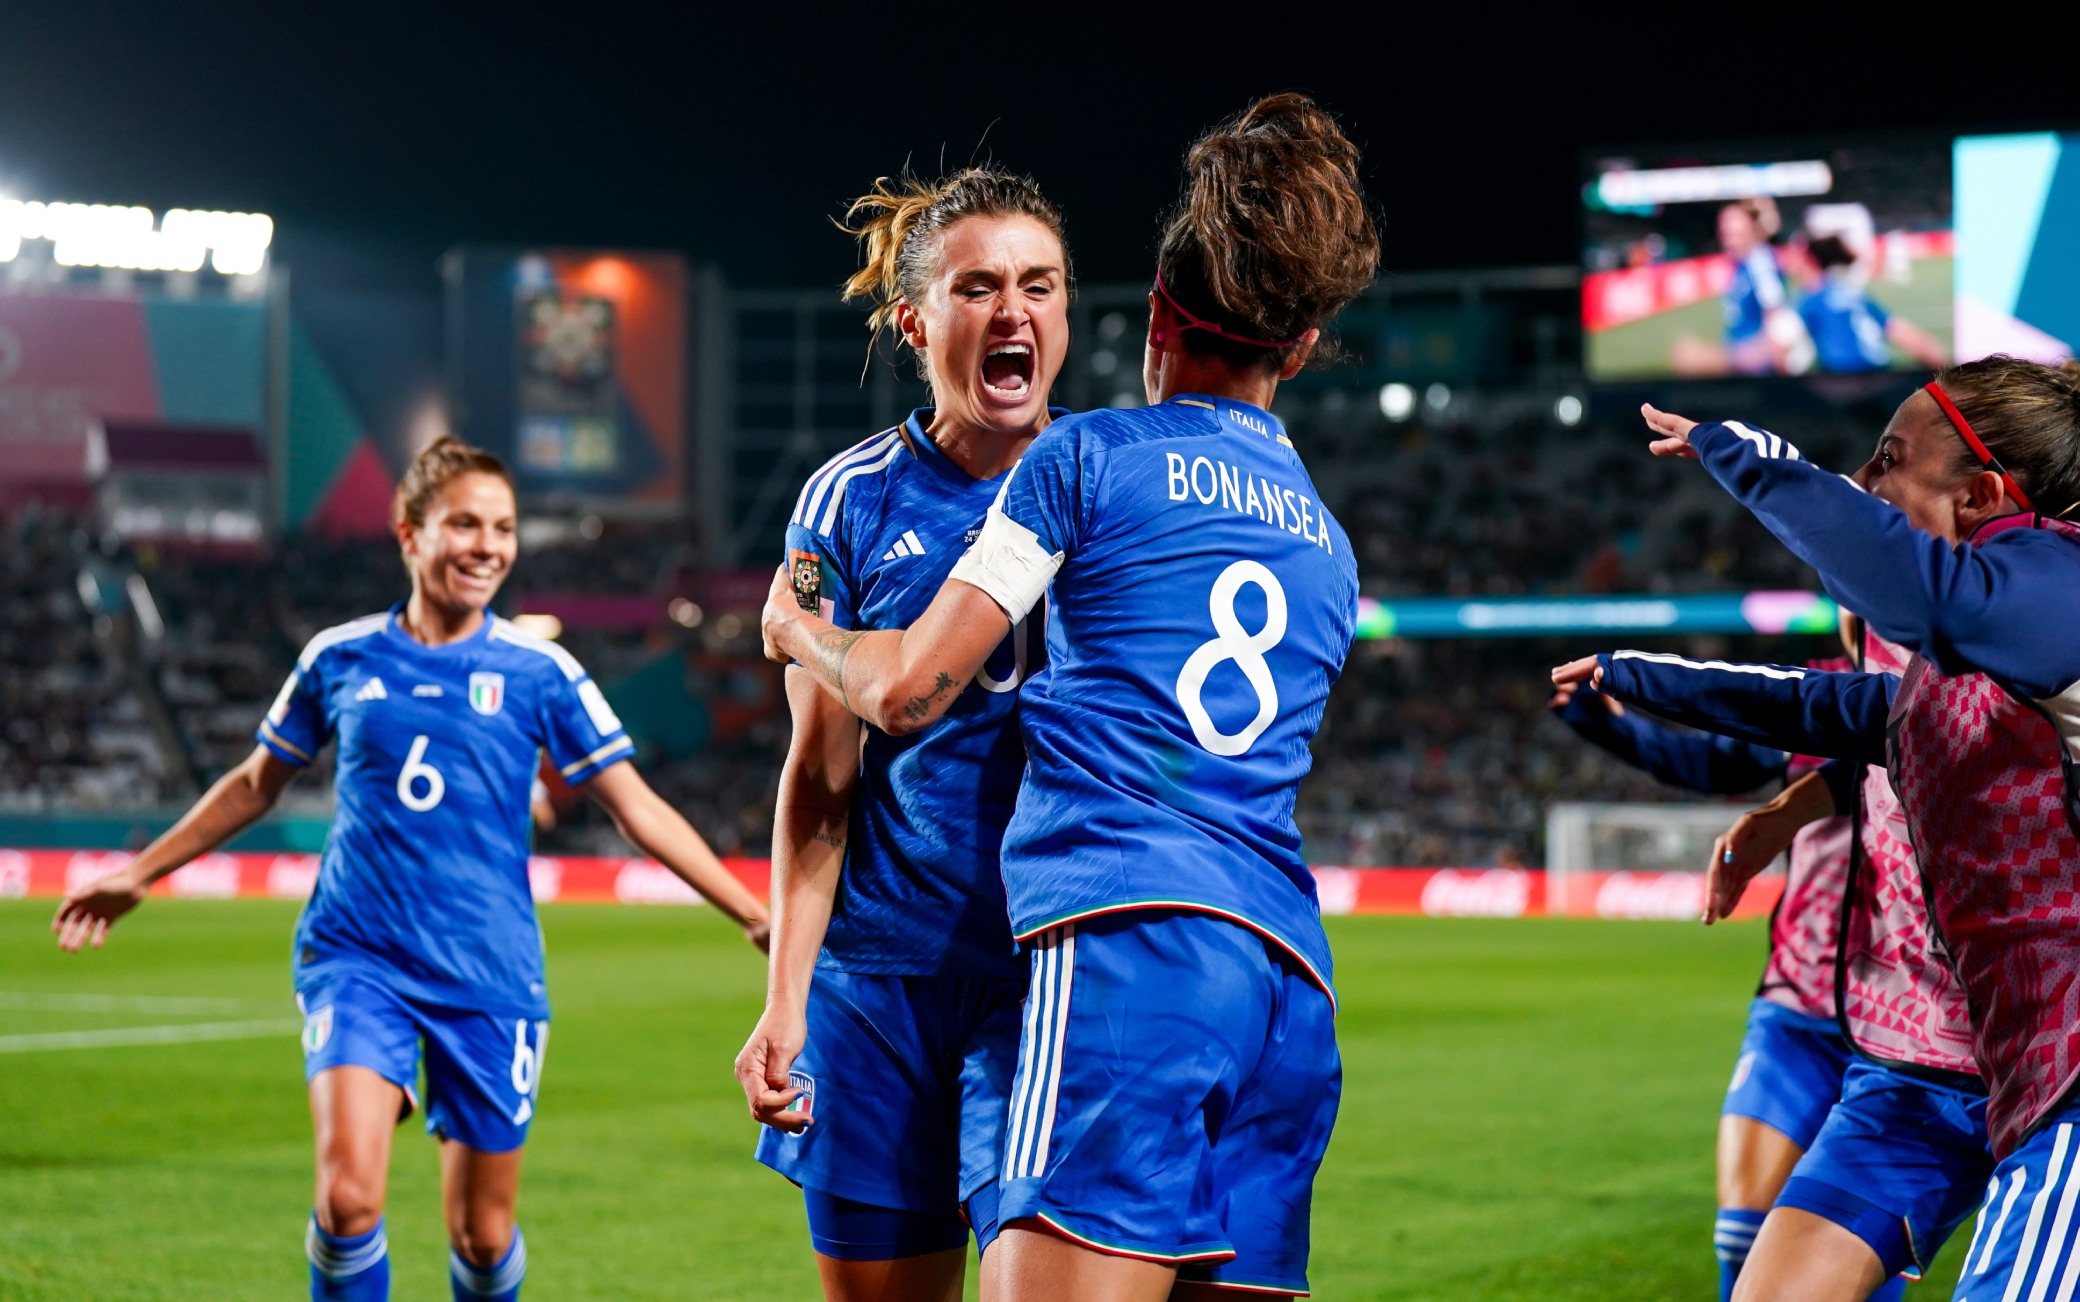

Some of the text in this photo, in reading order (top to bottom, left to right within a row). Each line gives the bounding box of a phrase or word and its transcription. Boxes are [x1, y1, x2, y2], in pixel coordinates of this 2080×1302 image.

[1229, 408, 1269, 438] ITALIA
[1165, 452, 1333, 555] BONANSEA
[1176, 560, 1287, 756] 8
[397, 734, 446, 813] 6
[511, 1018, 536, 1095] 6
[789, 1074, 812, 1094] ITALIA
